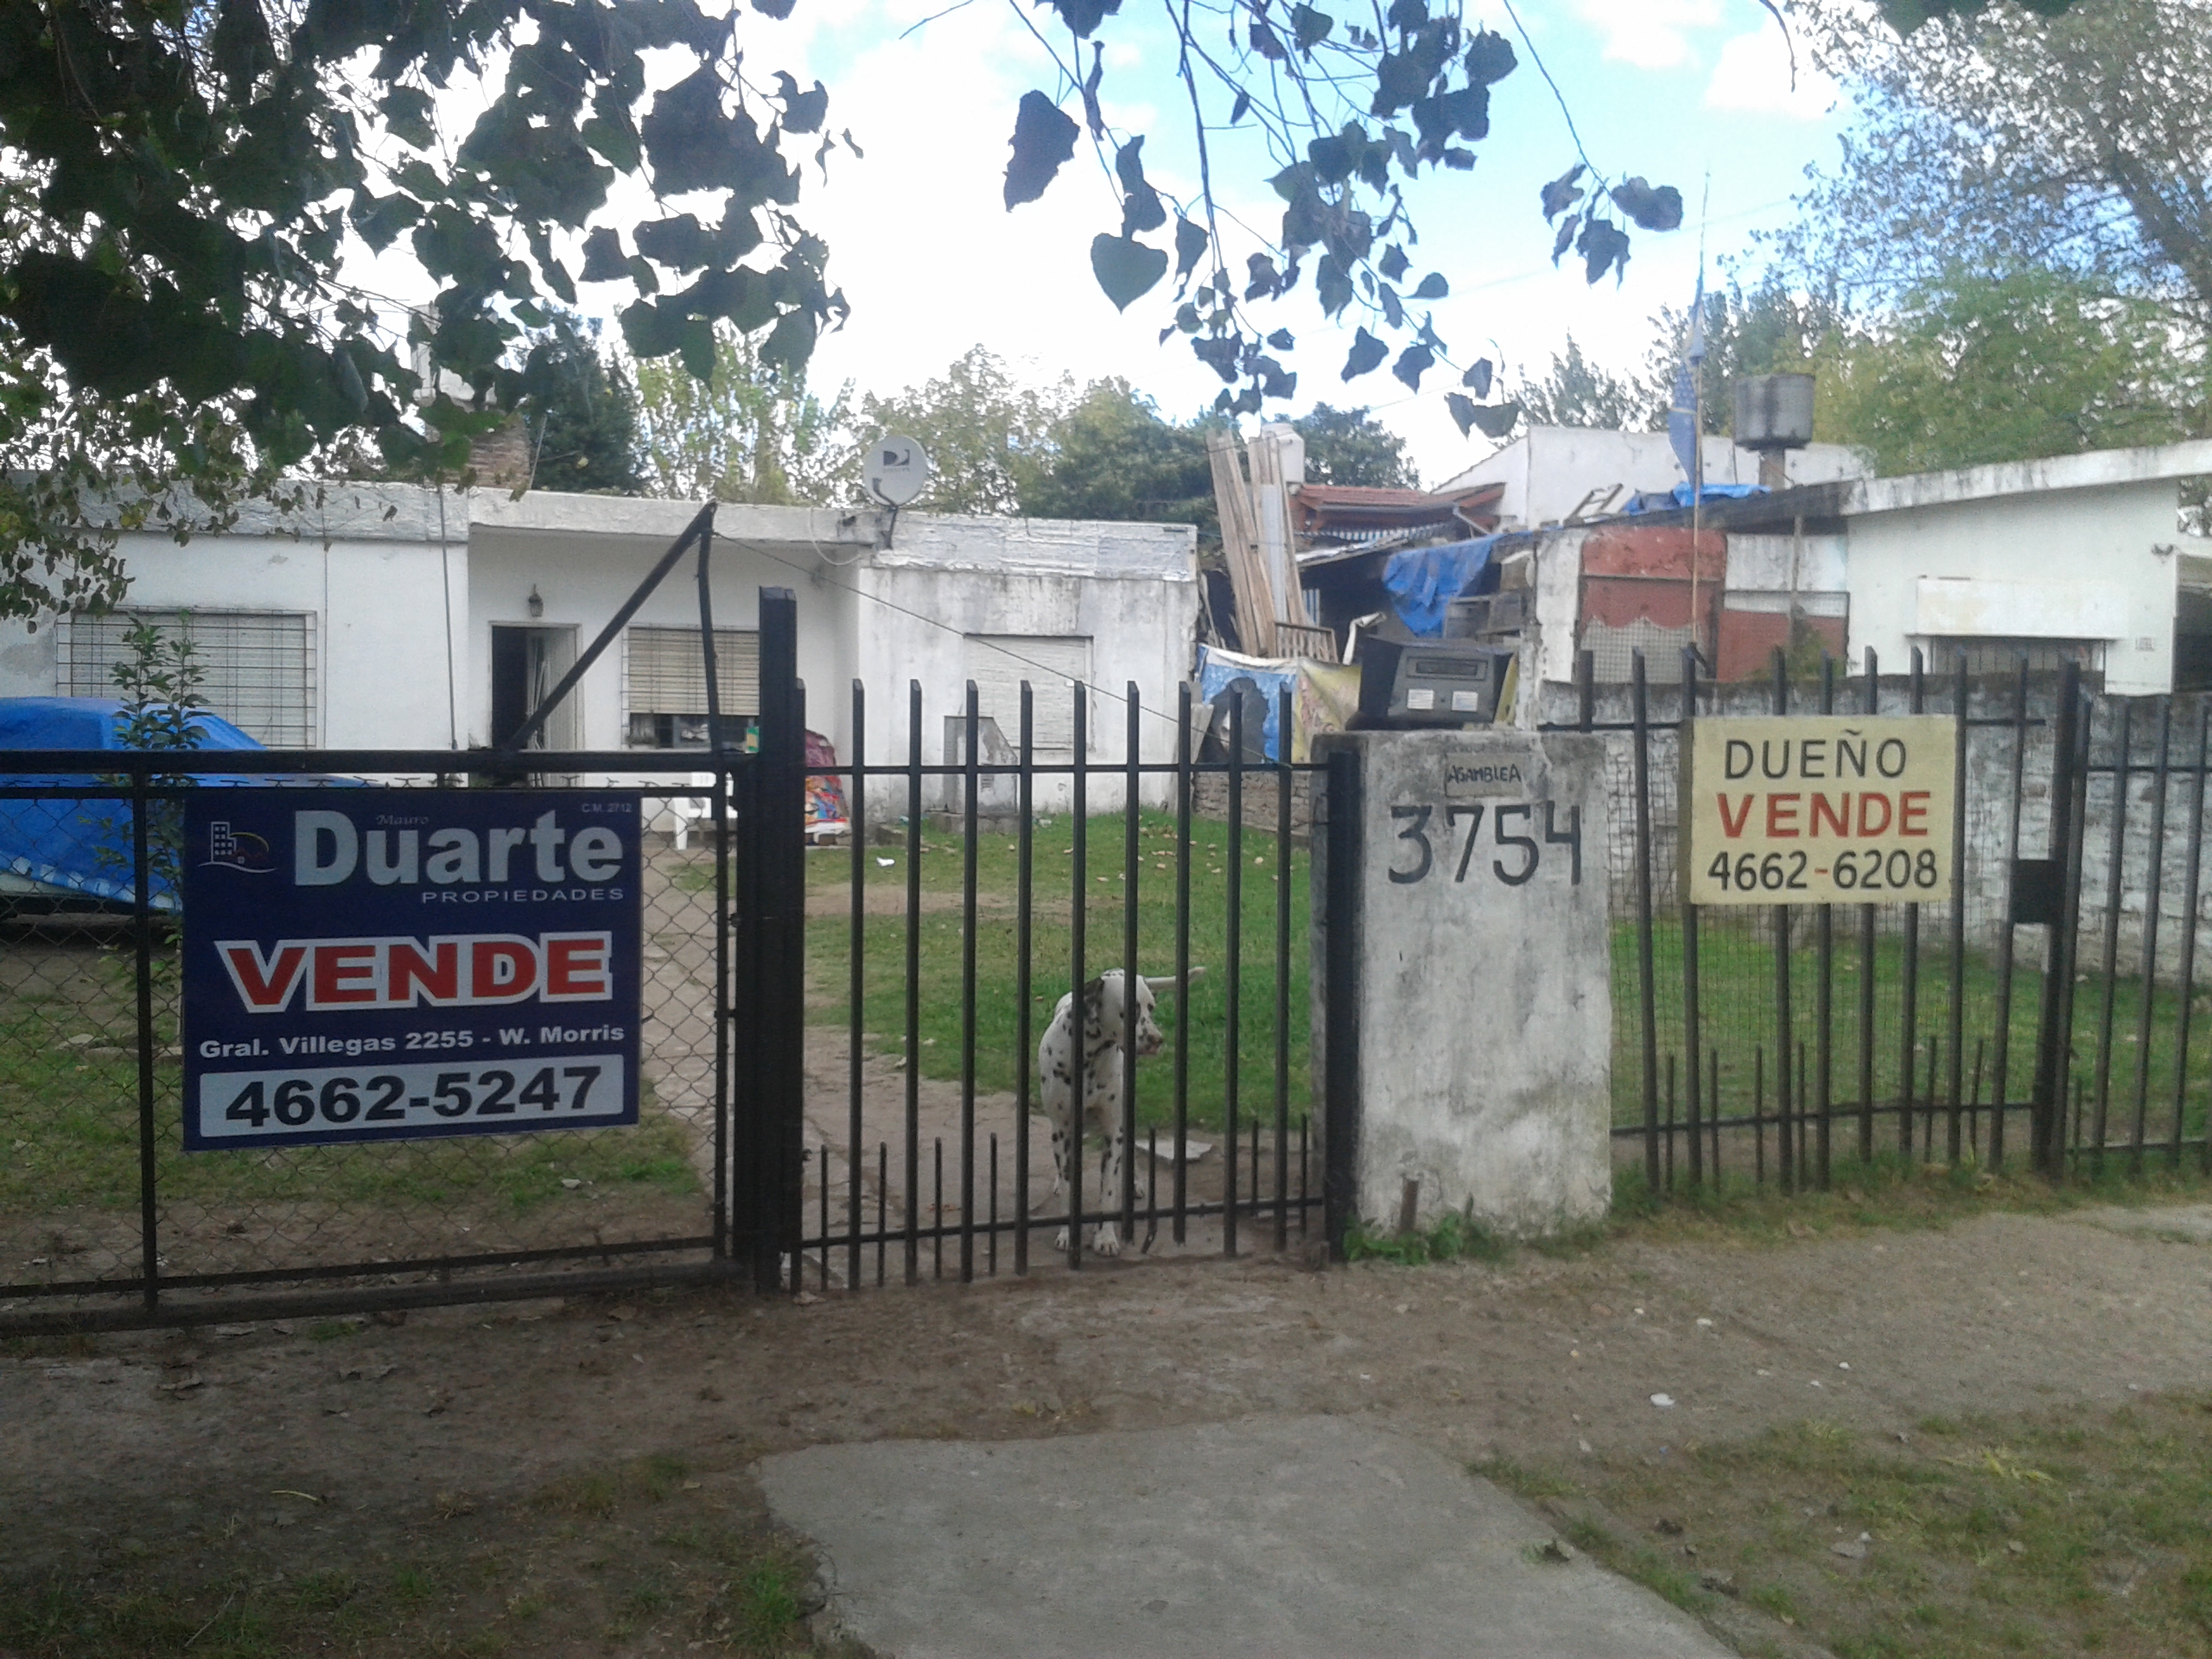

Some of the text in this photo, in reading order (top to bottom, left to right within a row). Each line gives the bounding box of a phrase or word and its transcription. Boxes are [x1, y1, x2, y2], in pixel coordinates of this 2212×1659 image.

[1724, 729, 1907, 779] DUEÑO
[376, 814, 429, 825] Mauro
[607, 802, 632, 813] 2712
[1716, 791, 1931, 838] VENDE
[295, 809, 624, 886] Duarte
[1388, 799, 1581, 887] 3754
[1707, 849, 1937, 891] 4662-6208
[422, 888, 624, 905] PROPIEDADES
[215, 931, 612, 1013] VENDE
[200, 1039, 269, 1058] Gral.
[279, 1036, 396, 1057] Villegas
[405, 1030, 474, 1050] 2255
[499, 1027, 531, 1046] W.
[540, 1024, 625, 1044] Morris
[226, 1065, 601, 1128] 4662-5247
